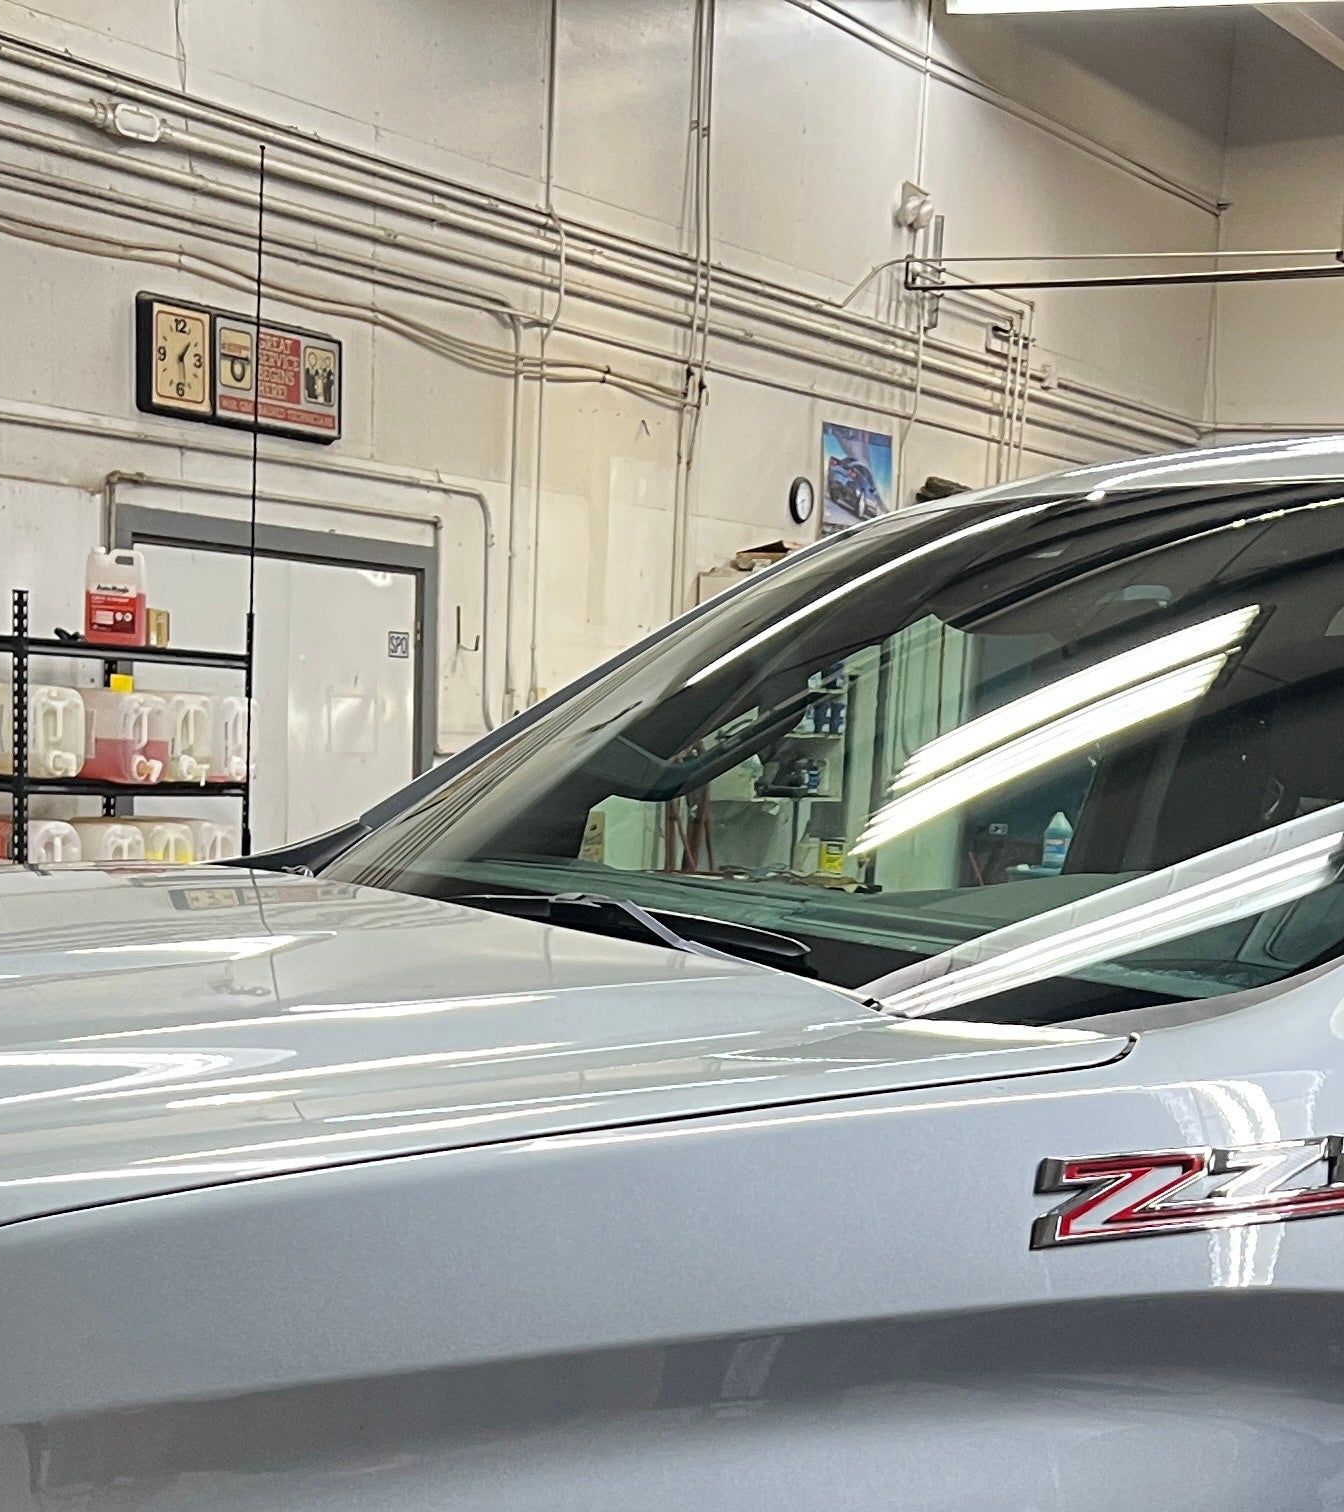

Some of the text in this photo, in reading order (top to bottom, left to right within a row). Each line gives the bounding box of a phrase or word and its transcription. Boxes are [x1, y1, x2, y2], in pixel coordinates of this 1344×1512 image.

[174, 318, 188, 335] 12
[158, 346, 167, 362] 9
[193, 353, 203, 369] 3
[176, 382, 186, 397] 6
